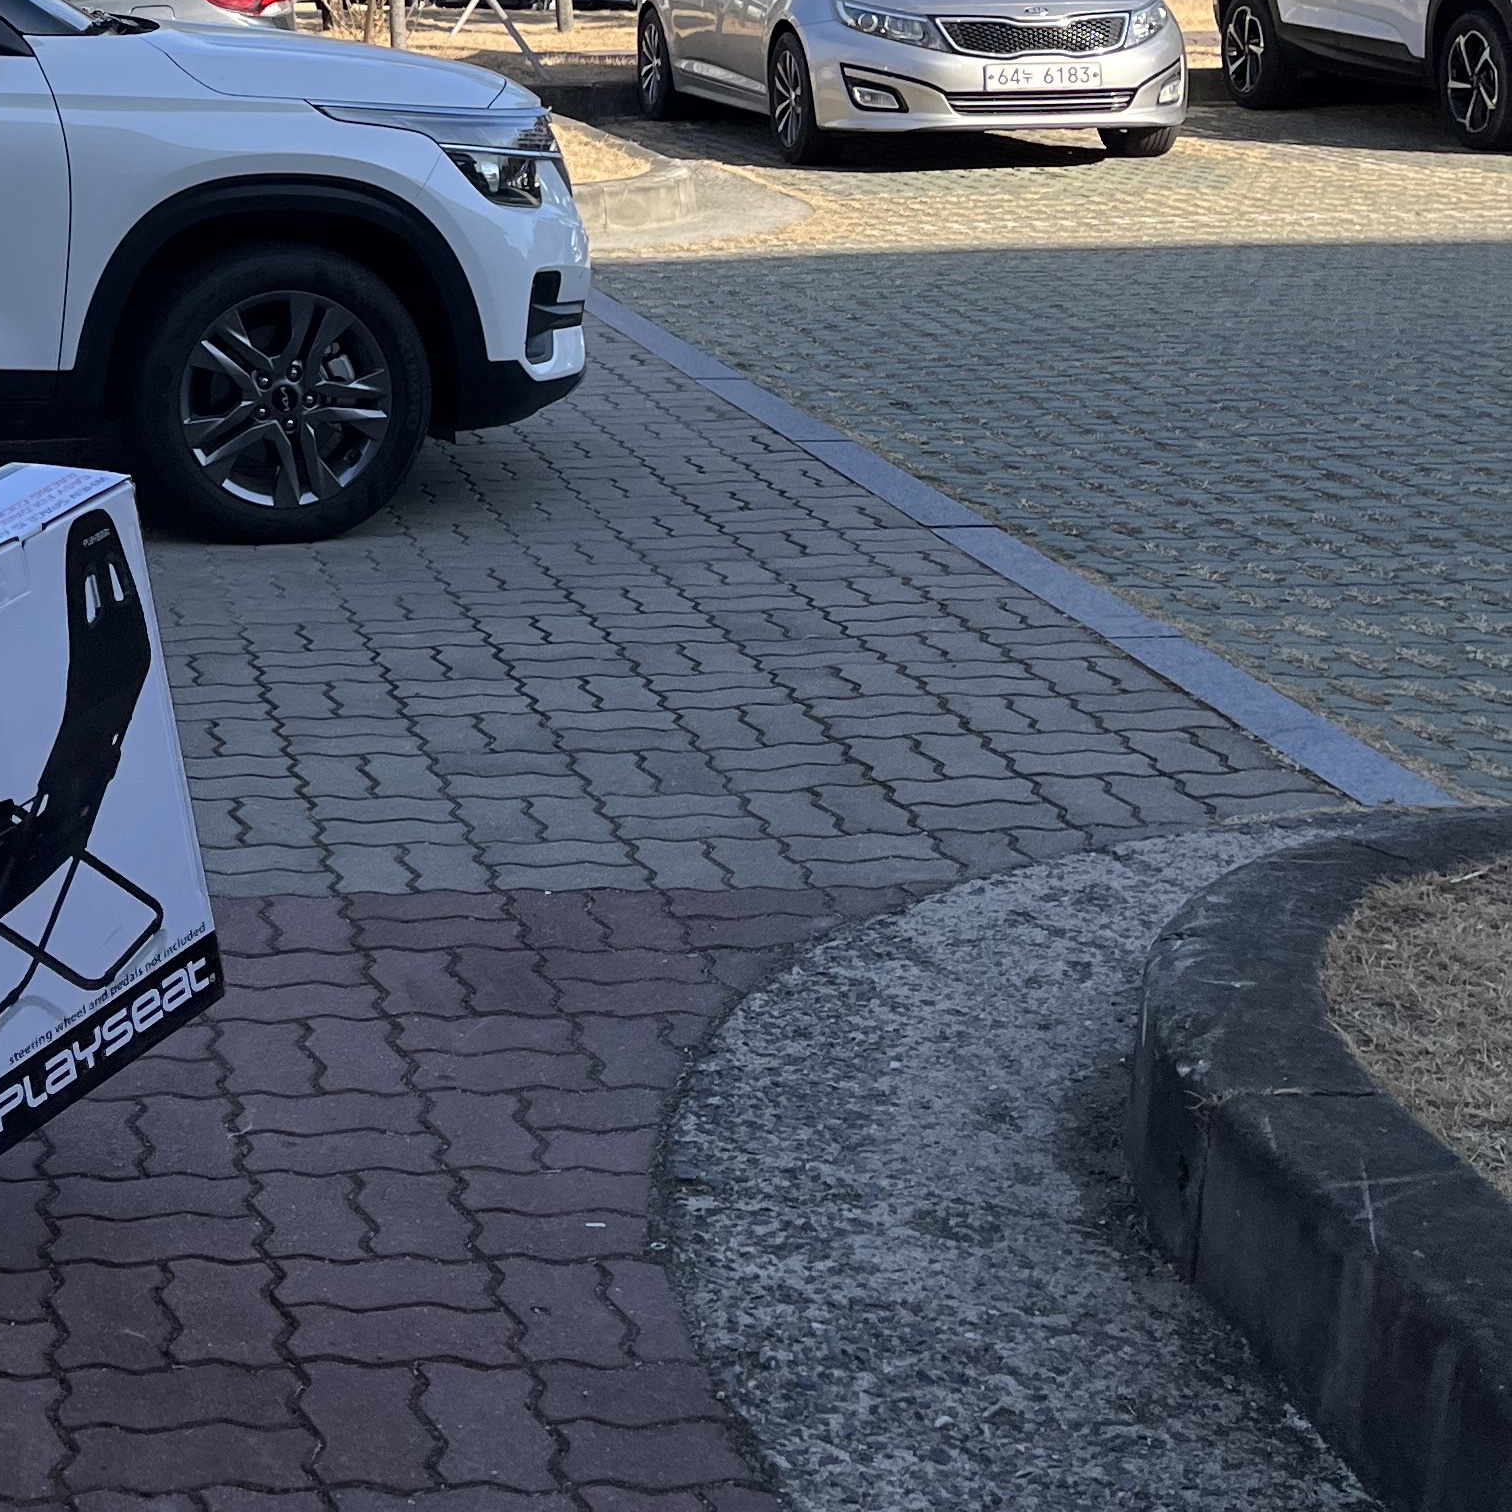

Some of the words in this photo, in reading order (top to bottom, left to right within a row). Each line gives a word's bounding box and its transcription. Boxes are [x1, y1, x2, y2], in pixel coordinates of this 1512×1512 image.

[1044, 67, 1090, 84] 6183
[8, 1029, 53, 1065] steering
[54, 1004, 87, 1033] wheel
[88, 988, 108, 1011] and
[110, 967, 143, 997] pedals
[145, 953, 162, 972] not
[162, 921, 206, 958] included
